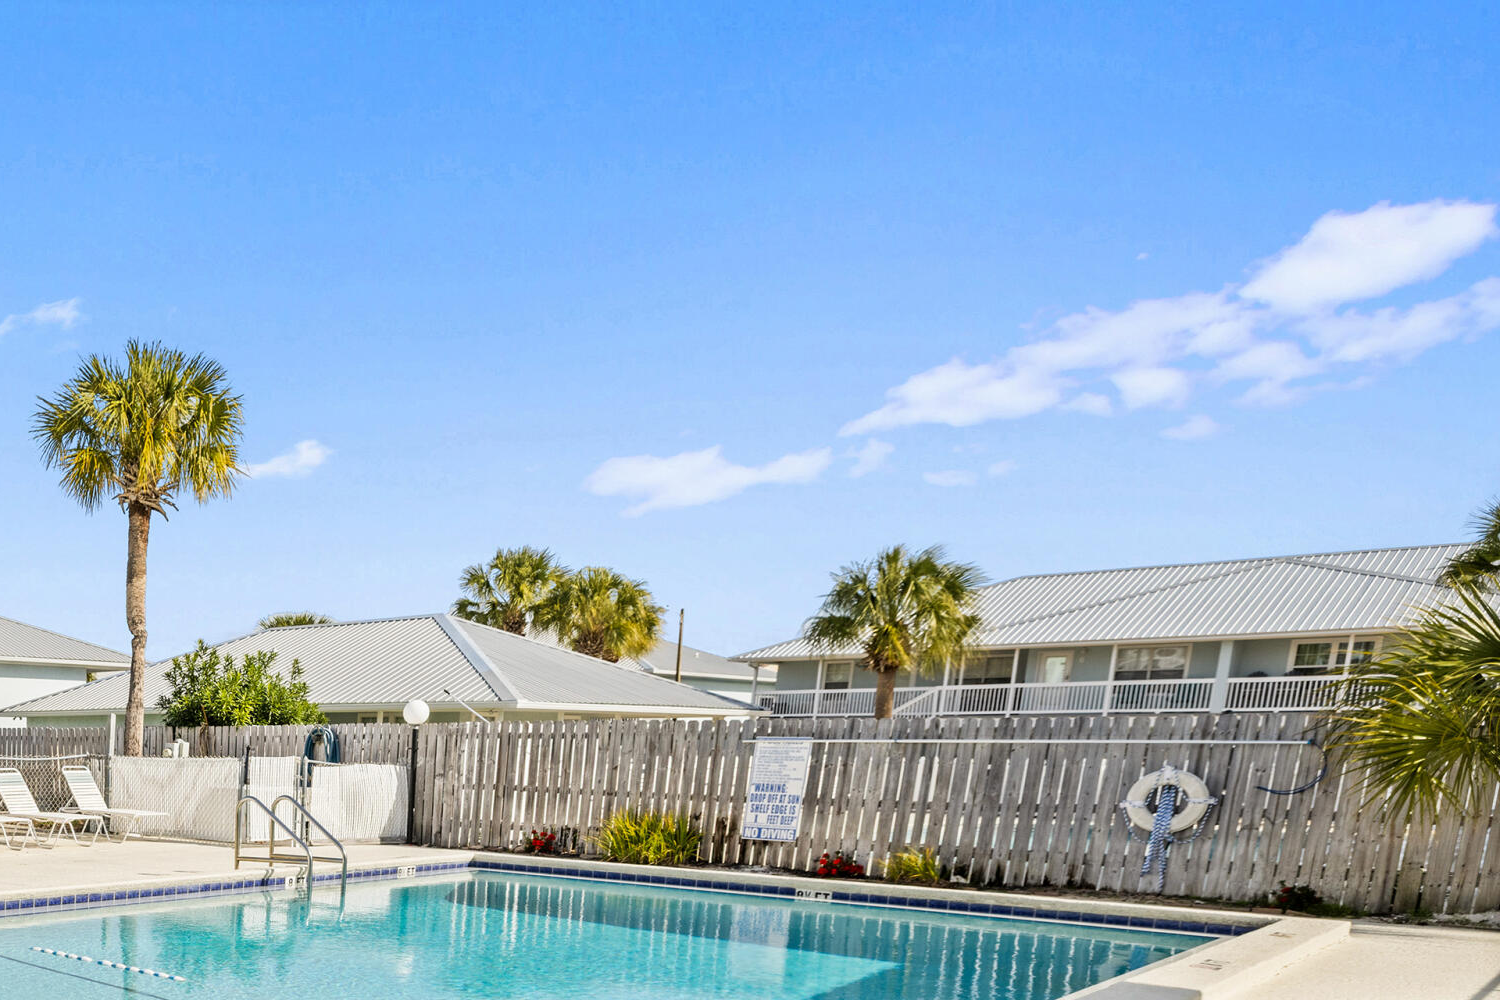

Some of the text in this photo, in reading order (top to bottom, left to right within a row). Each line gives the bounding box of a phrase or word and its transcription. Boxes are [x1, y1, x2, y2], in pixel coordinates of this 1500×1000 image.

[750, 793, 800, 804] DROP OFF AT SUN
[750, 803, 797, 815] SHELF EDGE IS
[766, 815, 780, 825] FEET
[743, 827, 795, 840] NO DIVING
